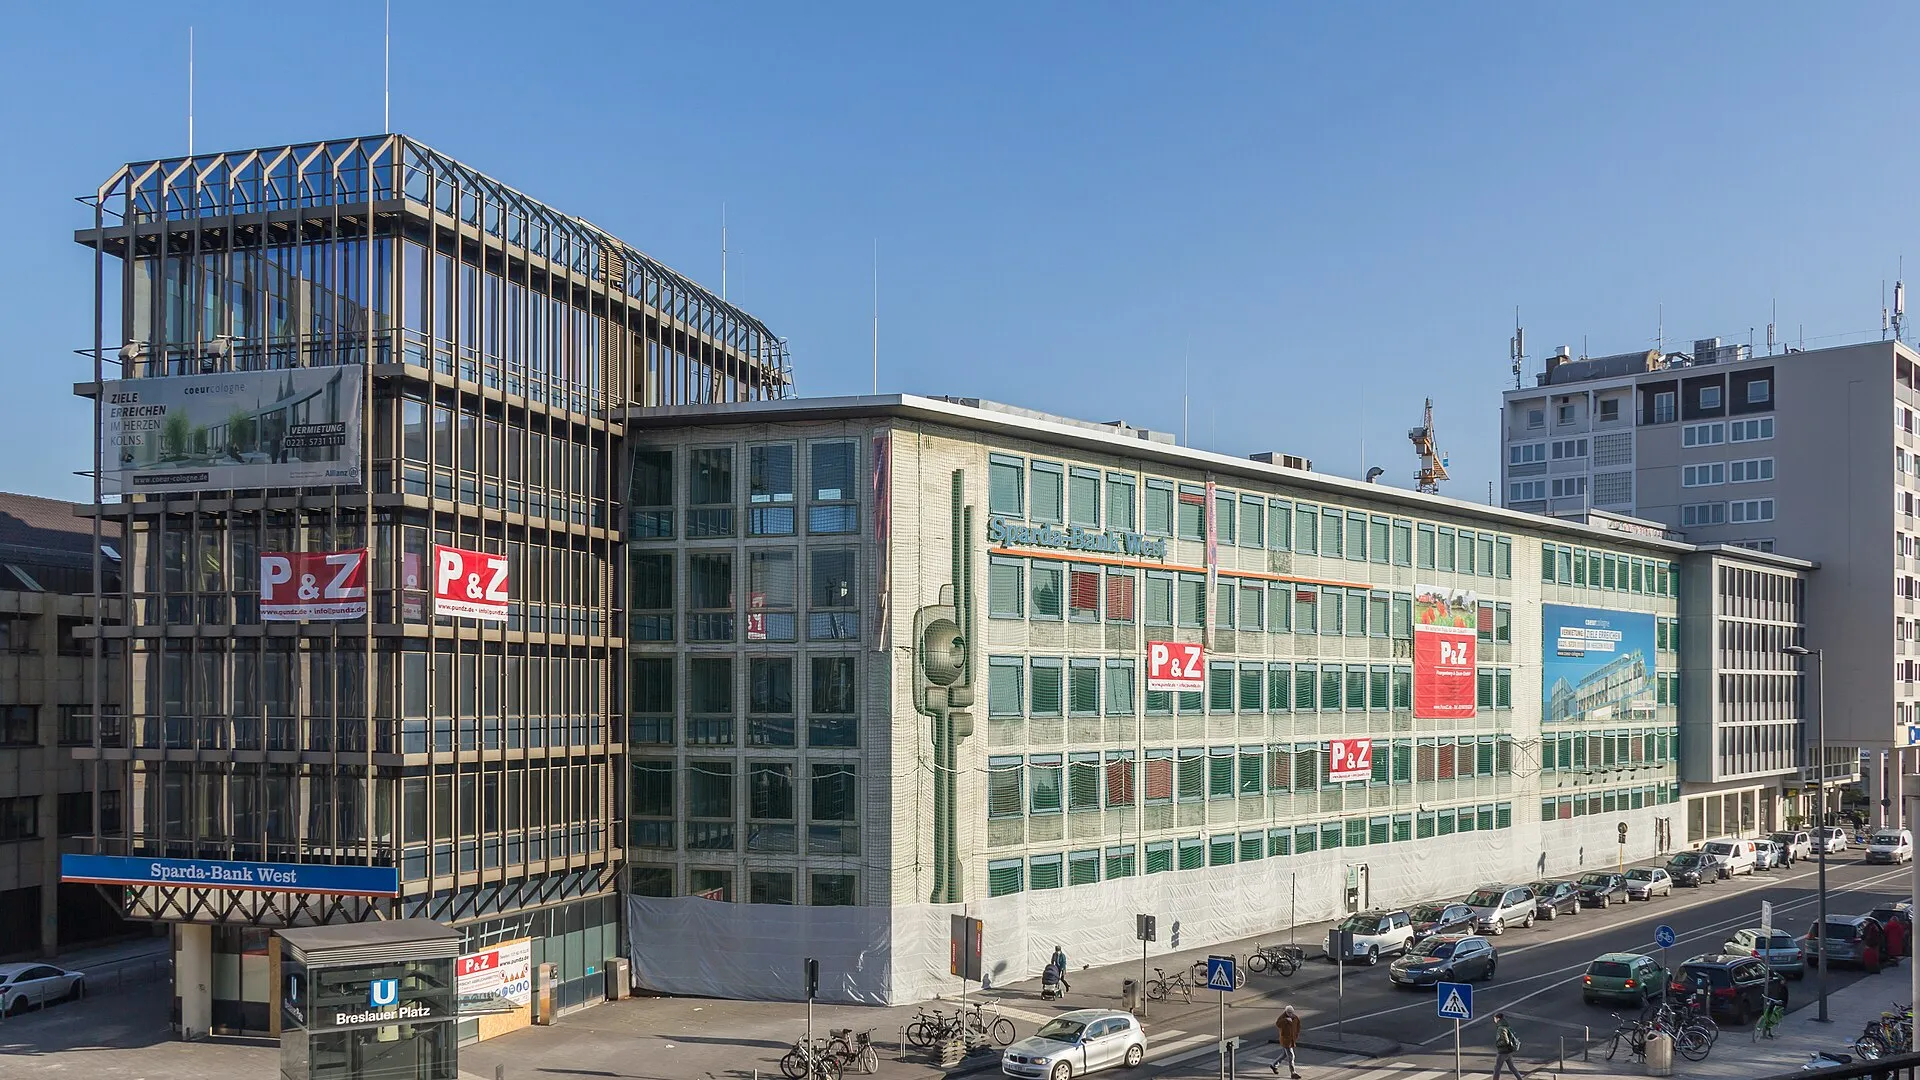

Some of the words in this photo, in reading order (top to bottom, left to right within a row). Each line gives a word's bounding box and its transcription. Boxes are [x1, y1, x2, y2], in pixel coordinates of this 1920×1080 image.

[184, 382, 246, 395] coeurcologne
[111, 392, 138, 404] ZIELE
[111, 405, 167, 418] ERREICHEN
[110, 422, 121, 432] IM
[123, 420, 160, 431] HERZEN
[291, 424, 345, 435] VERMIETUNG:
[989, 515, 1120, 554] Sparda-Bank
[1122, 531, 1168, 558] West
[150, 862, 253, 881] Sparda-Bank
[257, 867, 297, 883] West
[373, 980, 396, 1005] U
[336, 1010, 398, 1025] Breslauer
[398, 1006, 431, 1019] Platz
